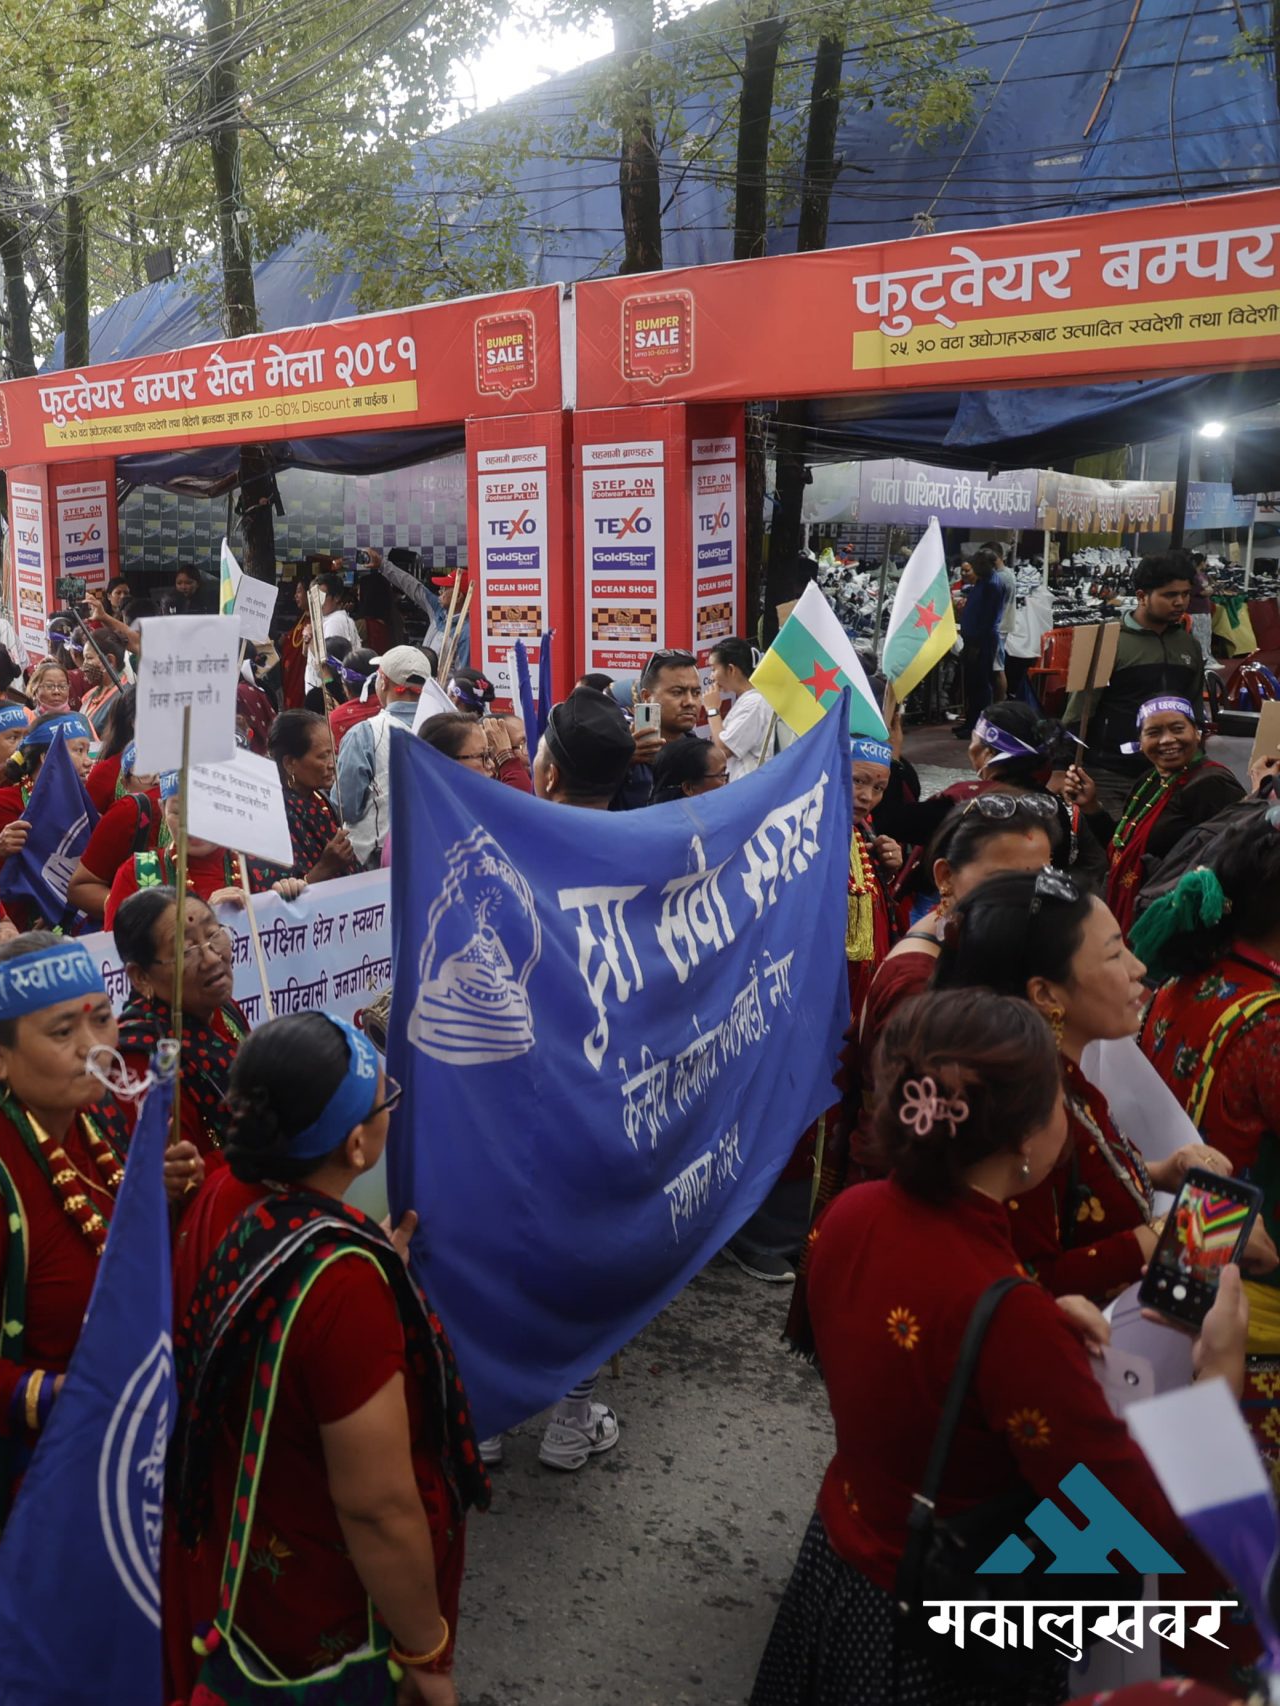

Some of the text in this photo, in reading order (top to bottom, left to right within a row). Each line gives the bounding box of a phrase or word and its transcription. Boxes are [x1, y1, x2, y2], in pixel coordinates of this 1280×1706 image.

[852, 223, 1280, 338] फुट्वेयर बम्पर
[635, 316, 679, 331] BUMPER
[941, 335, 963, 351] वटा
[1063, 321, 1122, 340] उत्पादित
[1130, 314, 1184, 334] स्वदेशी
[1189, 311, 1222, 329] तथा
[1228, 304, 1278, 325] विदेशी
[486, 334, 523, 349] BUMPER
[635, 328, 679, 349] SALE
[486, 347, 524, 365] SALE
[38, 335, 417, 428] फुट्वेयर बम्पर सेल मेला २०८१
[257, 400, 300, 420] 10-60%
[302, 396, 351, 414] Discount
[486, 482, 538, 493] STEP ON
[592, 479, 654, 490] STEP ON
[698, 474, 731, 486] STEP ON
[486, 494, 513, 502] Footwear
[592, 490, 624, 498] Footwear
[871, 477, 902, 506] माता
[64, 508, 84, 516] STEP
[699, 502, 730, 536] TEXO
[488, 509, 537, 541] TEXO
[595, 507, 652, 540] TEXO
[18, 526, 39, 546] TEXO
[65, 523, 101, 546] TEXO
[487, 551, 537, 563] GoldStar
[594, 551, 653, 562] GoldStar
[698, 547, 730, 561] GoldStar
[488, 582, 539, 592] OCEAN SHOE
[594, 584, 654, 594] OCEAN SHOE
[698, 579, 731, 592] OCEAN SHOE
[312, 912, 334, 951] क्षेत्र
[339, 914, 348, 945] र
